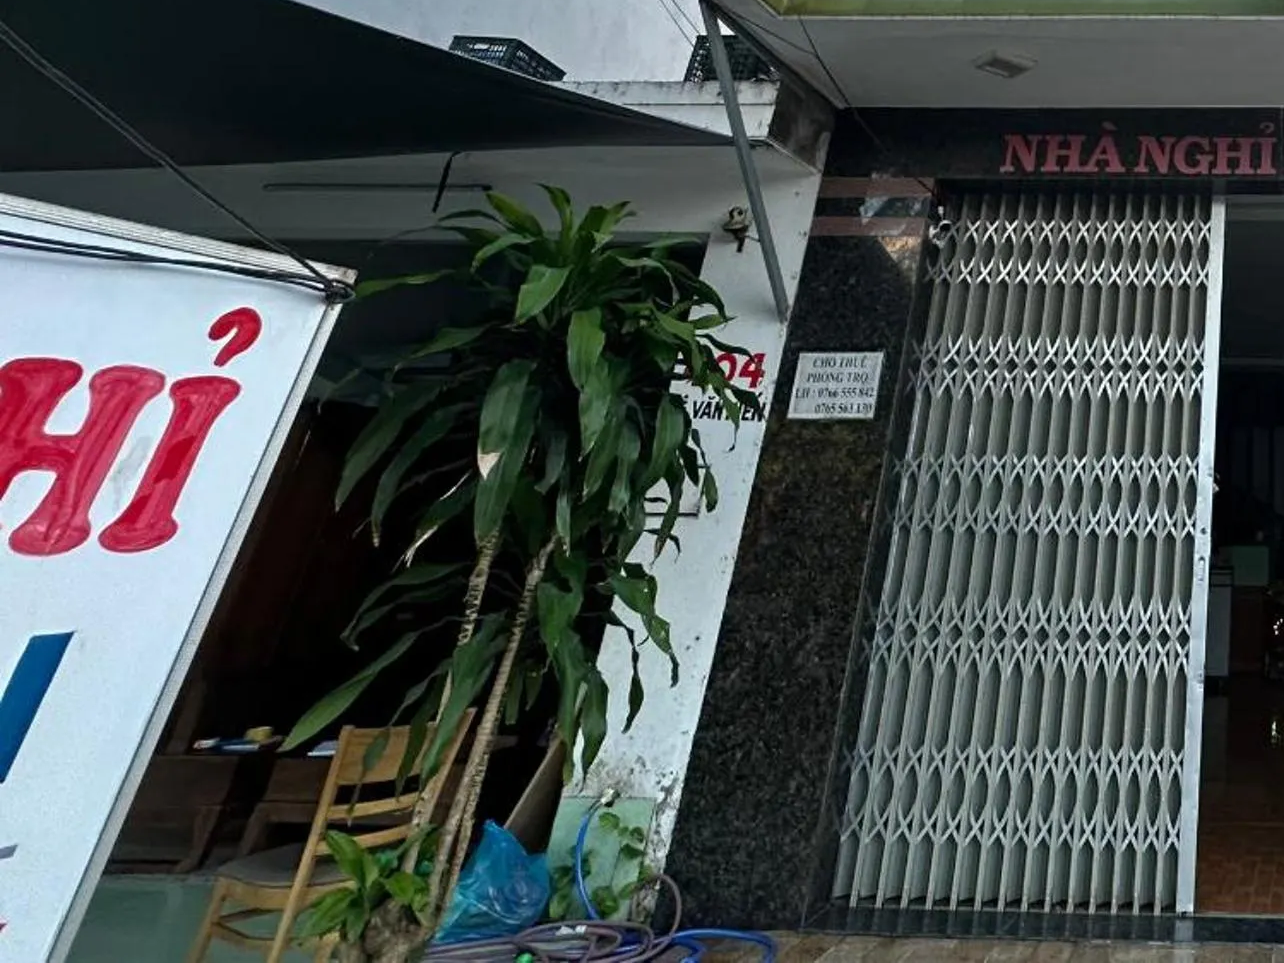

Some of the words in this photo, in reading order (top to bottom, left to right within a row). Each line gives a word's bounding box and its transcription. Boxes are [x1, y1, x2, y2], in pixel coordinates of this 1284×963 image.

[1000, 122, 1126, 173] NHÀ
[1134, 122, 1277, 175] NGHỈ
[813, 355, 836, 368] CHO
[841, 387, 857, 398] 555
